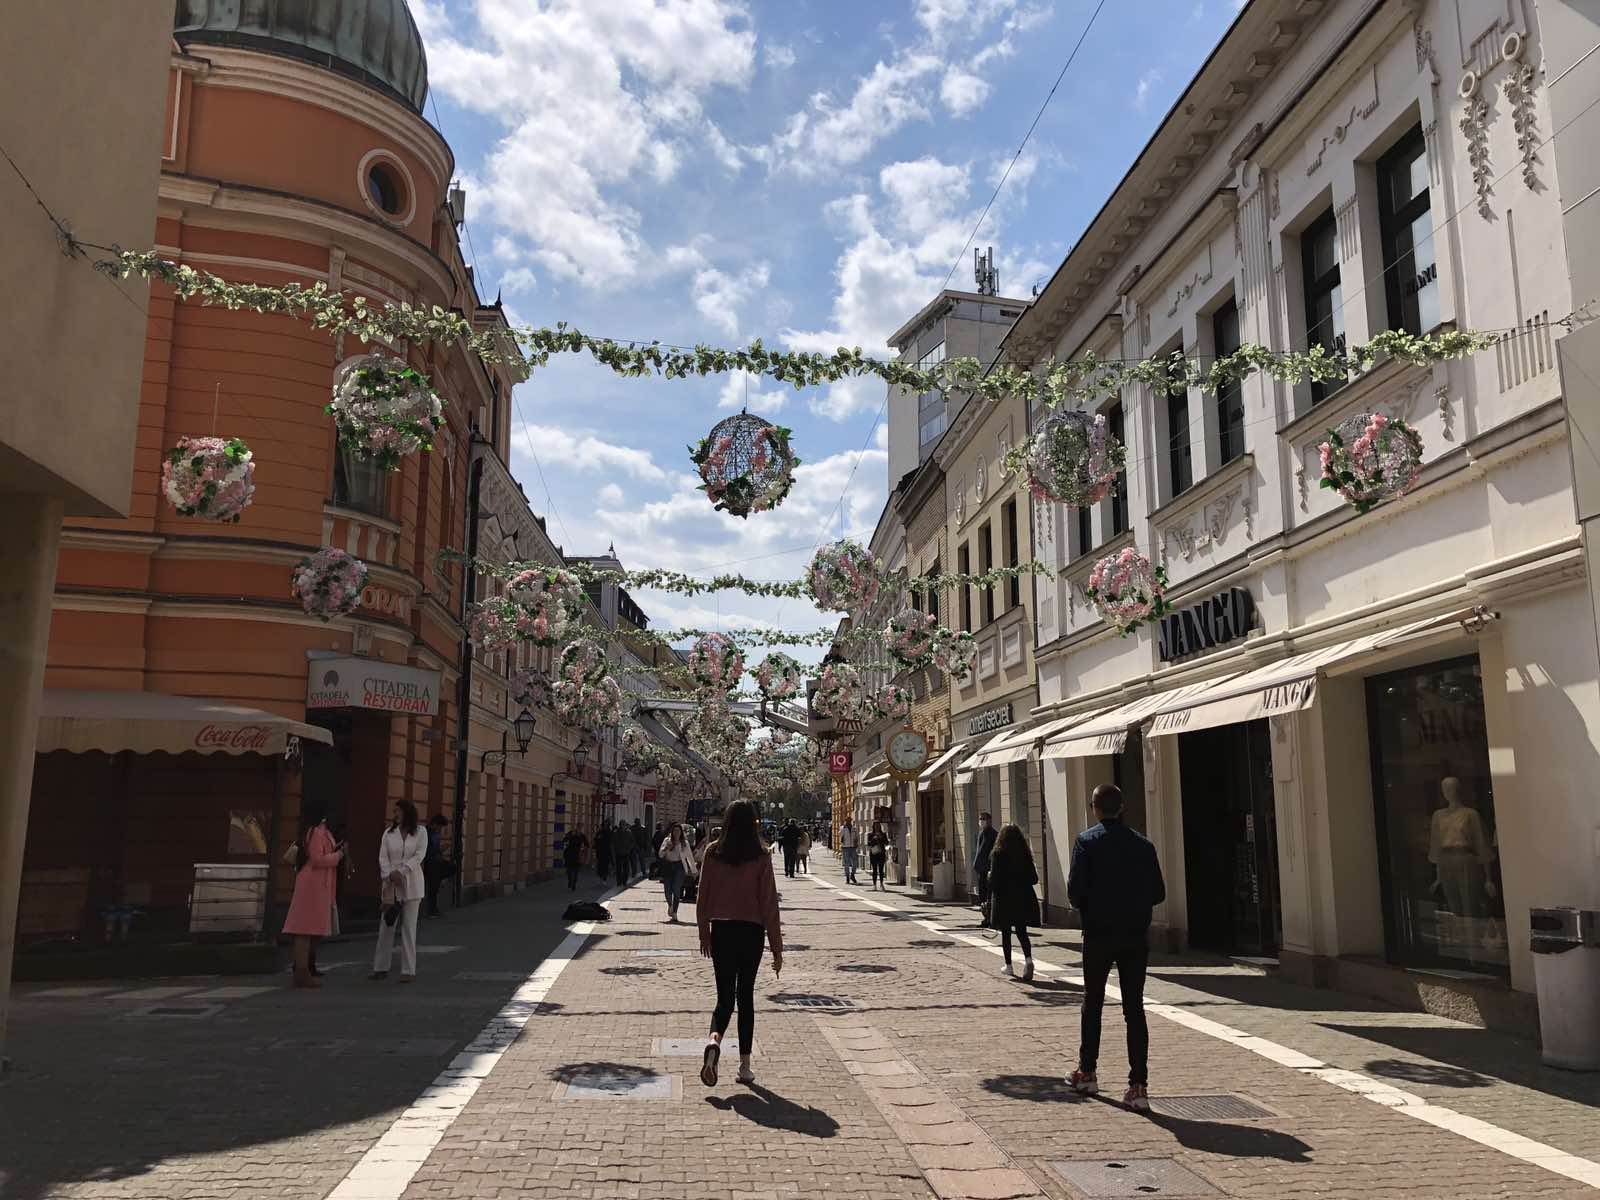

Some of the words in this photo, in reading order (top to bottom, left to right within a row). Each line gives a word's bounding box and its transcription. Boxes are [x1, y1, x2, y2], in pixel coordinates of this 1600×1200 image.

[1158, 586, 1251, 662] MANGO
[363, 676, 431, 699] CITADELA
[1263, 681, 1314, 711] MANGO
[363, 692, 431, 713] RESTORAN
